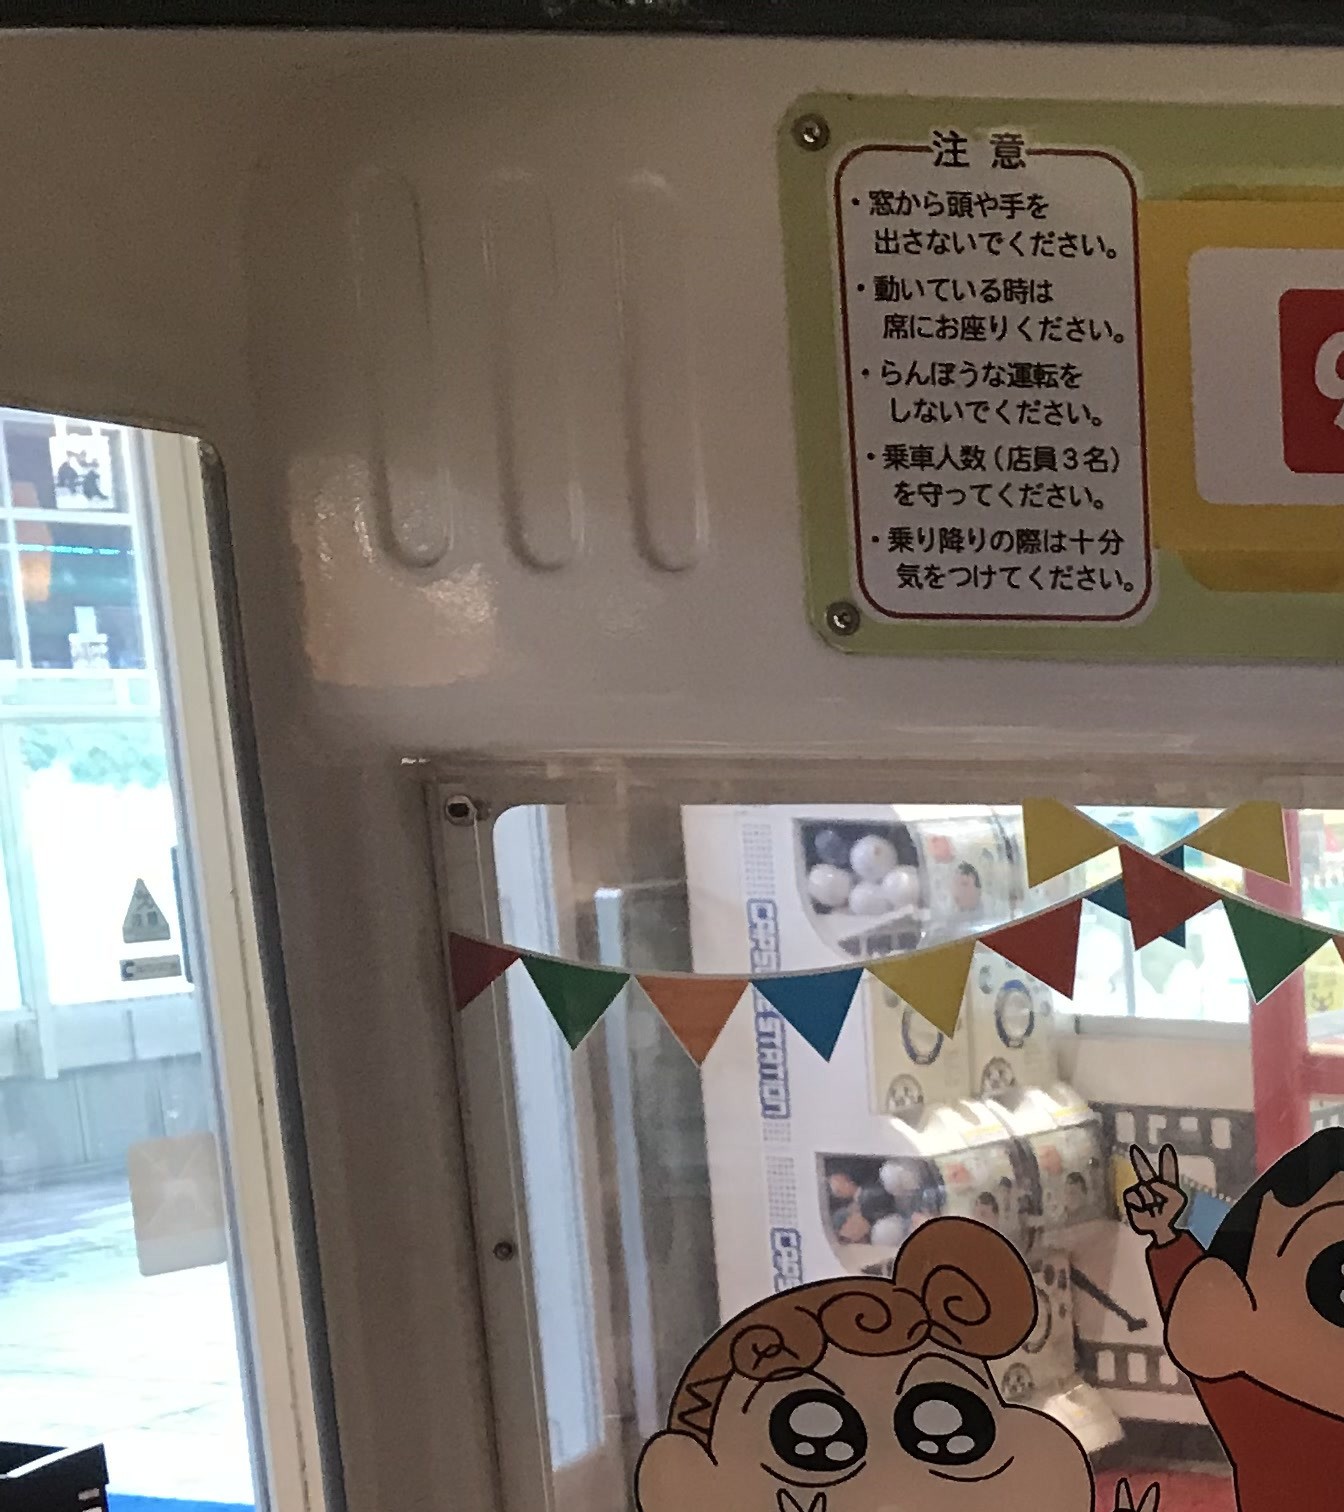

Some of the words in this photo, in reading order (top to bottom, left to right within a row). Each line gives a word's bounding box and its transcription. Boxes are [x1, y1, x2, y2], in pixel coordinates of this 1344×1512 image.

[932, 130, 1027, 169] 注意
[875, 230, 1116, 260] 出さないでください。
[874, 276, 1053, 303] 動いている時は
[883, 316, 1125, 344] 席にお座りください。
[891, 398, 1103, 427] しないでください。
[894, 481, 1104, 510] を守ってください。
[888, 527, 1124, 555] 乗り降りの際は十分
[897, 564, 1133, 593] 気をつけてください。
